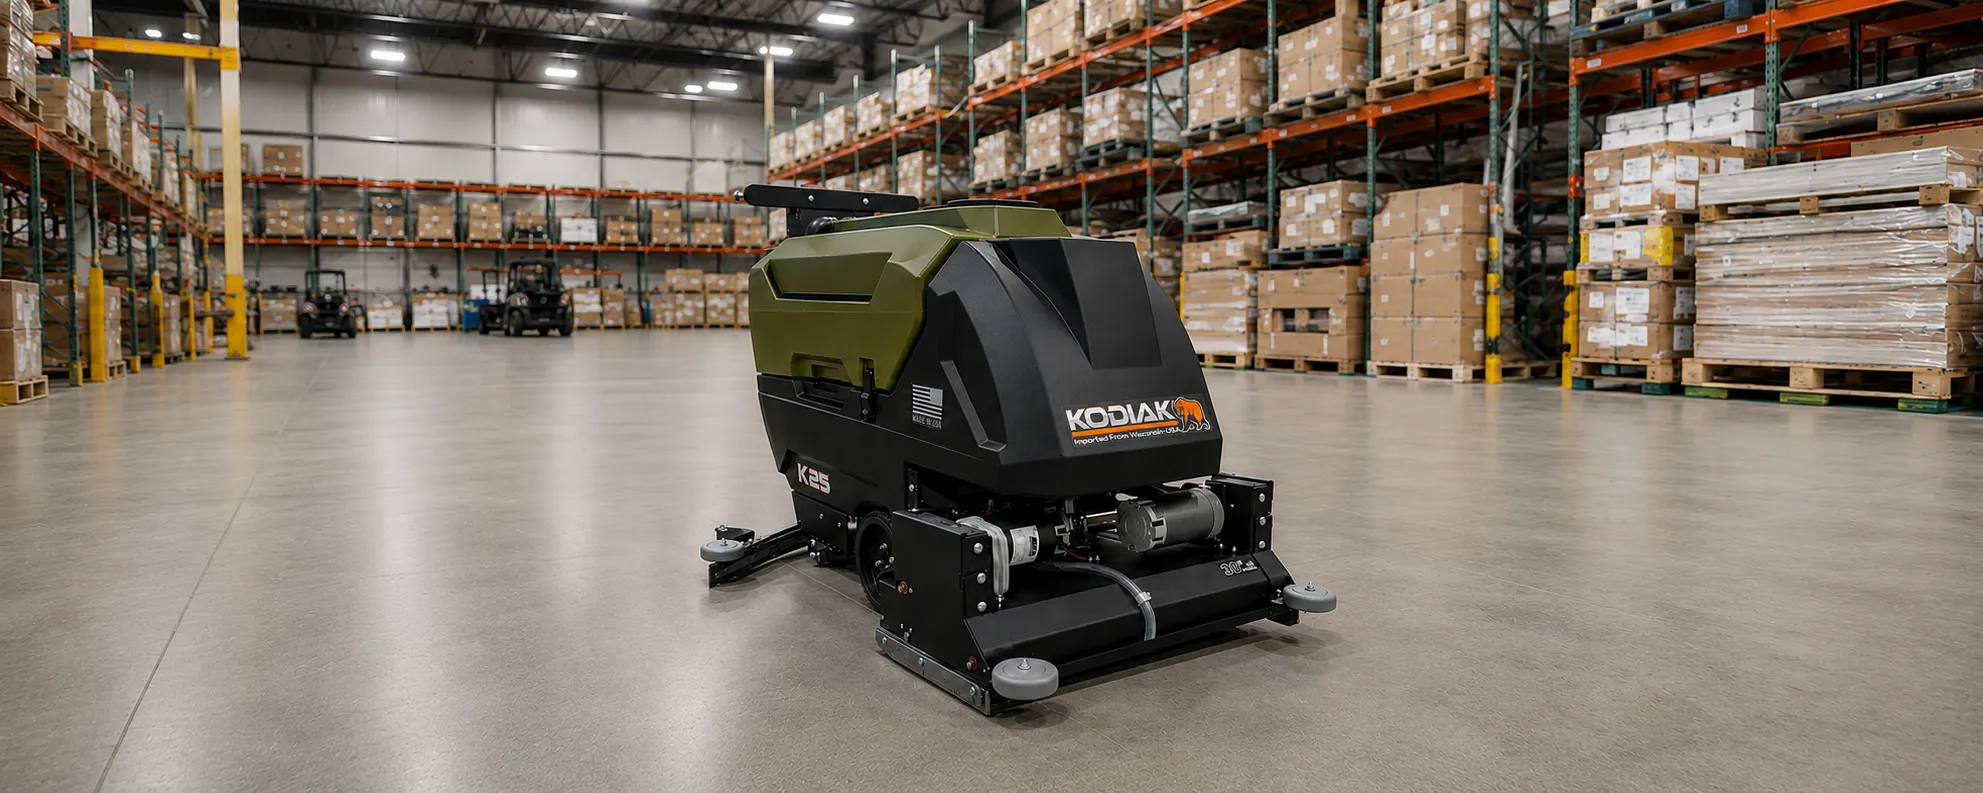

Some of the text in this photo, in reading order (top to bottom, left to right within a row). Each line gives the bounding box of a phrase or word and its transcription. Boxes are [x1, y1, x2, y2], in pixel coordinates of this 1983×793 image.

[1065, 400, 1176, 431] KODIAK
[1109, 433, 1129, 441] From
[797, 462, 831, 494] K25
